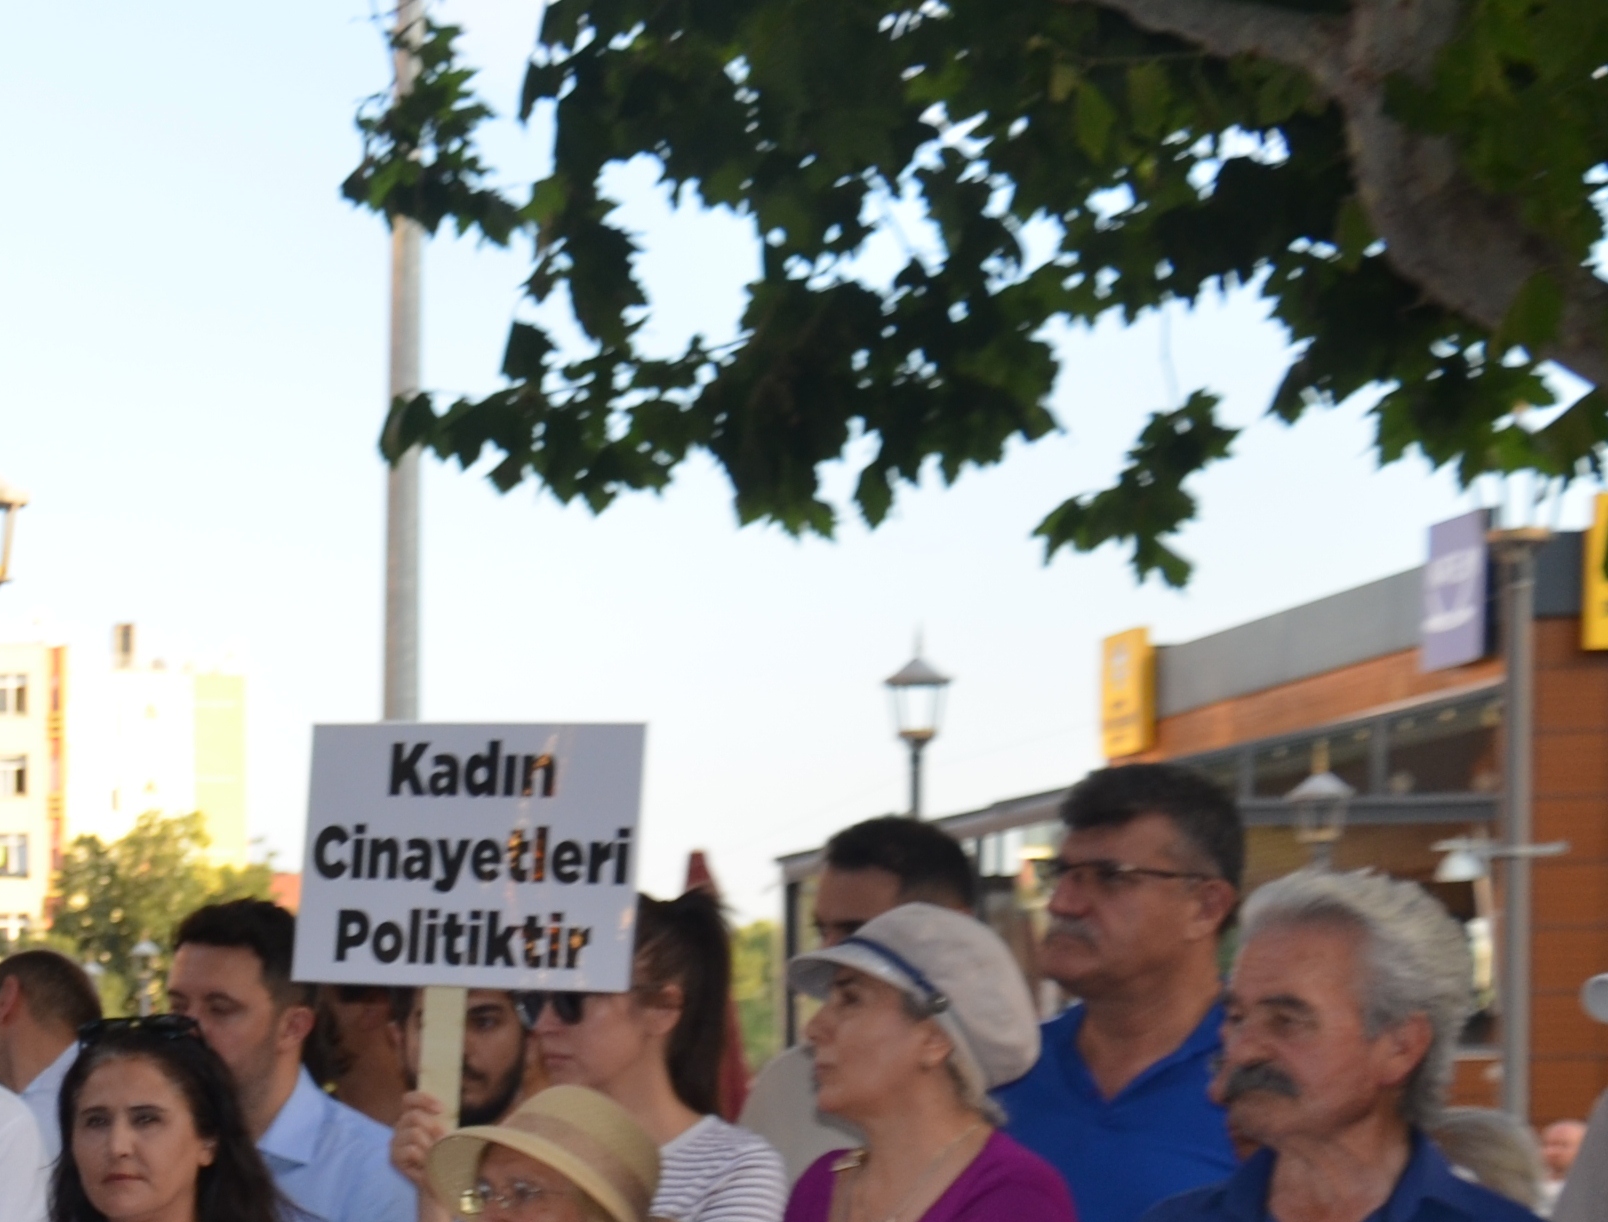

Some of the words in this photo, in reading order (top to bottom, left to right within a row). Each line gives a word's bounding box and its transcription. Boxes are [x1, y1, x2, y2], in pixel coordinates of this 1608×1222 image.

[388, 740, 558, 798] Kadın
[314, 824, 632, 893] Cinayetleri
[335, 908, 593, 970] Politiktir
